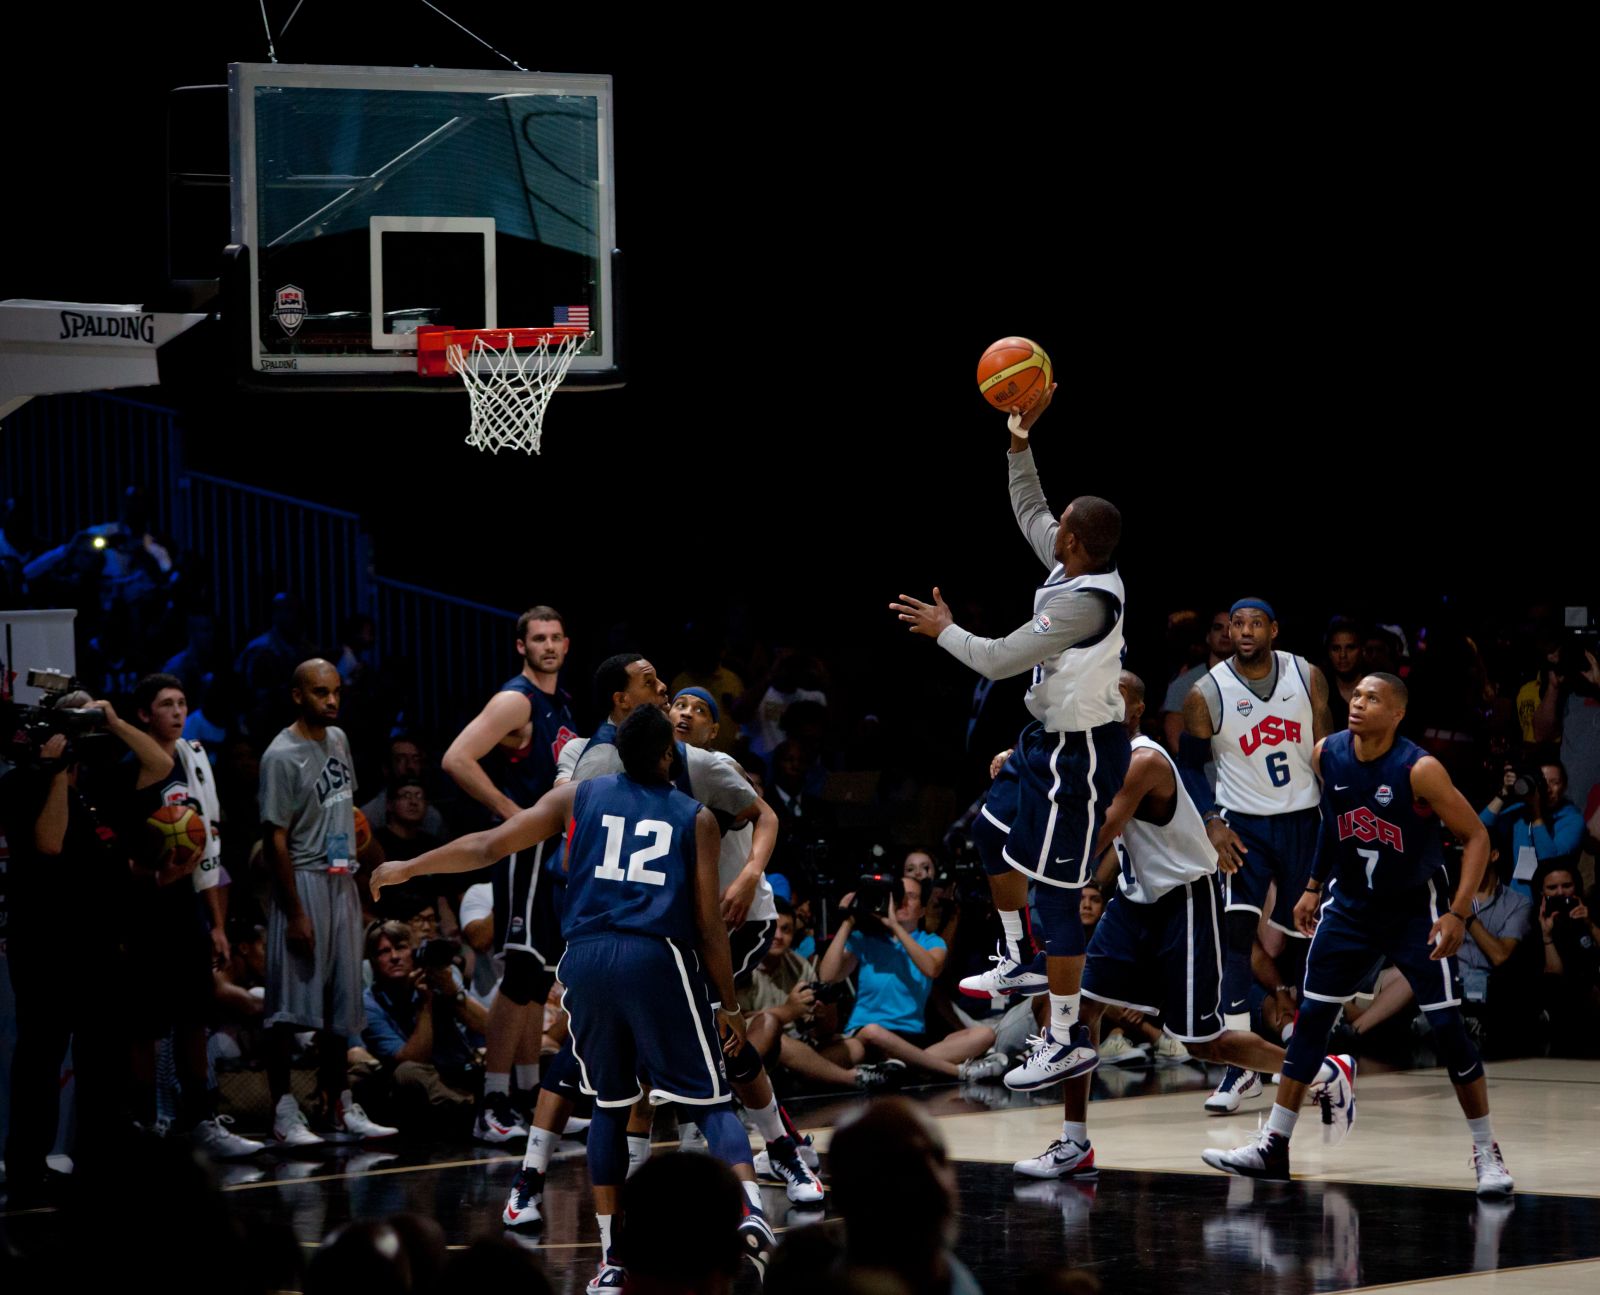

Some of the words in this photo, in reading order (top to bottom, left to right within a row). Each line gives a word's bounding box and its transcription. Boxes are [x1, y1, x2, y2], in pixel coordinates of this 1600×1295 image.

[60, 311, 153, 343] SPALDING
[261, 359, 297, 371] SPALDING
[1239, 715, 1301, 756] USA
[1265, 751, 1291, 787] 6
[594, 814, 674, 887] 12
[1337, 806, 1404, 854] USA
[1356, 847, 1380, 890] 7
